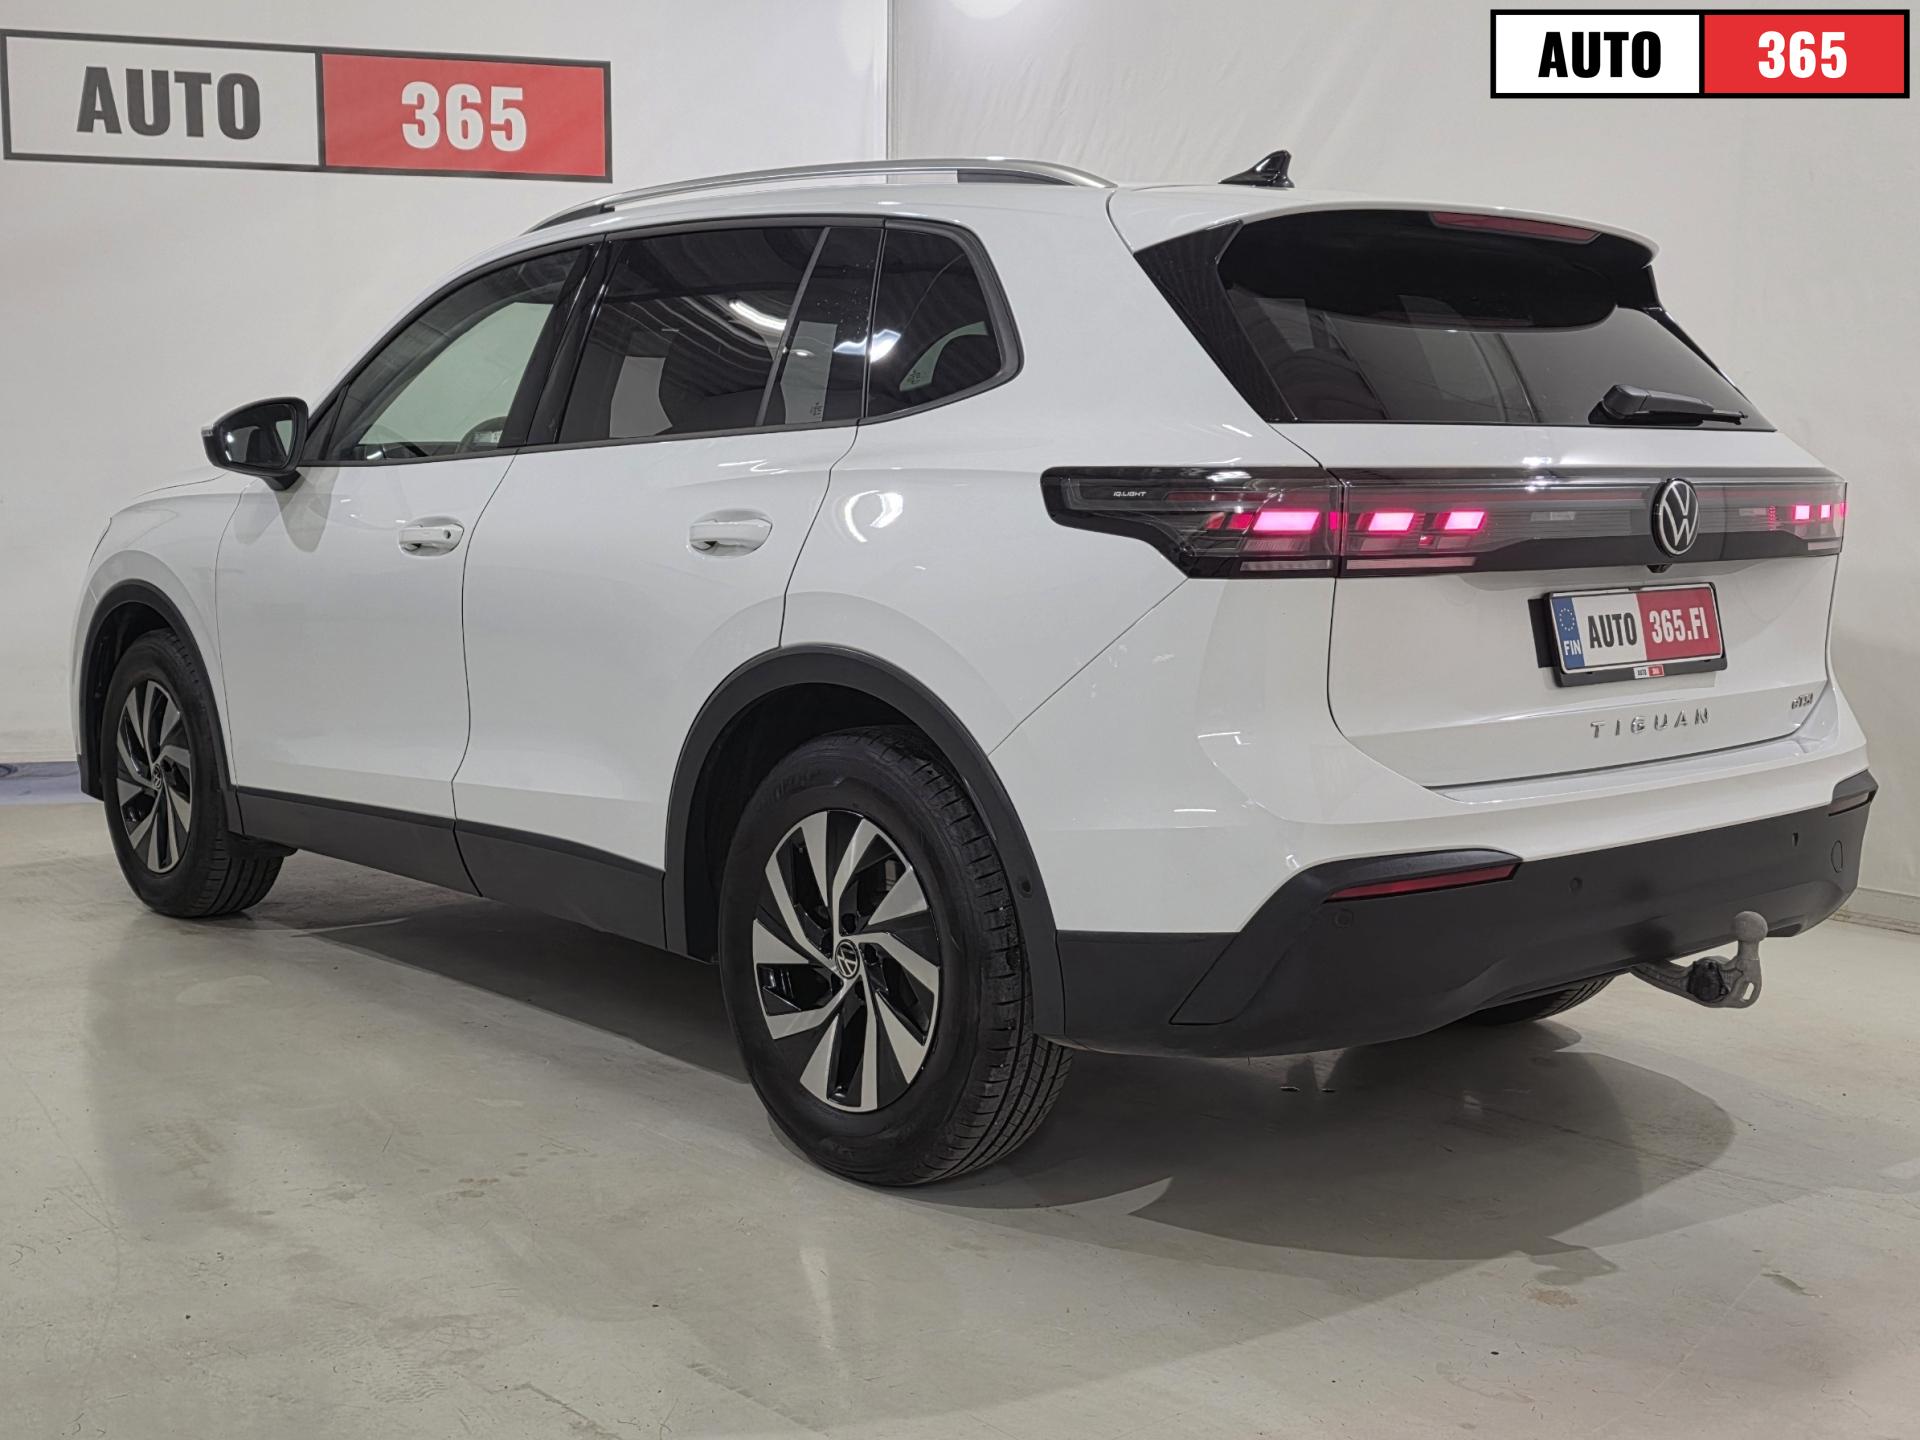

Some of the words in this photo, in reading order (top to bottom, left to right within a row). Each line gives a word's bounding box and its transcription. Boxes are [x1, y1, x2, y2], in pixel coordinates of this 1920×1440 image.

[77, 66, 261, 140] AUTO
[401, 81, 527, 152] 365
[1588, 612, 1638, 649] AUTO
[1649, 607, 1709, 643] 365.FI
[1564, 639, 1582, 656] FIN
[1591, 707, 1710, 738] TIGUAN
